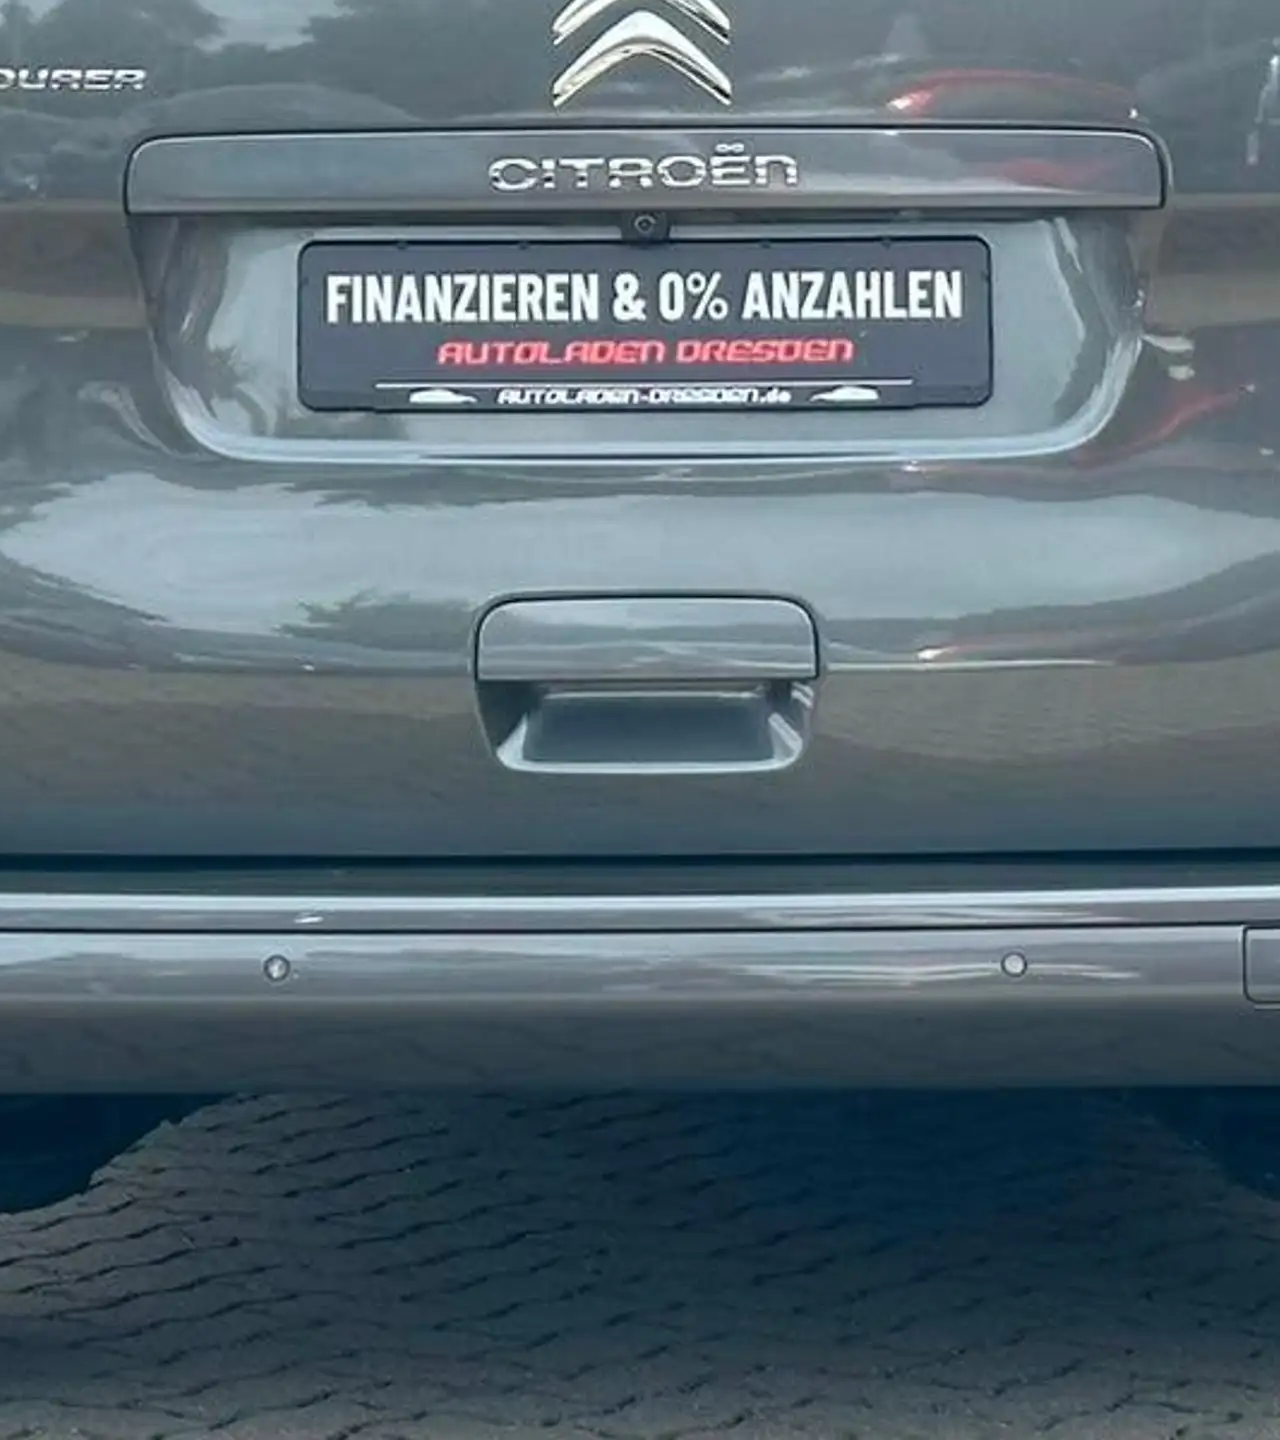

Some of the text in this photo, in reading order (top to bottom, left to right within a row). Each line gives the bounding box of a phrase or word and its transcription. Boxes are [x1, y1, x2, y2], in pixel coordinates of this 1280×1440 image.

[488, 142, 798, 191] CITROËN
[326, 270, 963, 324] FINANZIEREN & 0% ANZAHLEN
[436, 338, 855, 365] AUTOLADEN DRESDEN
